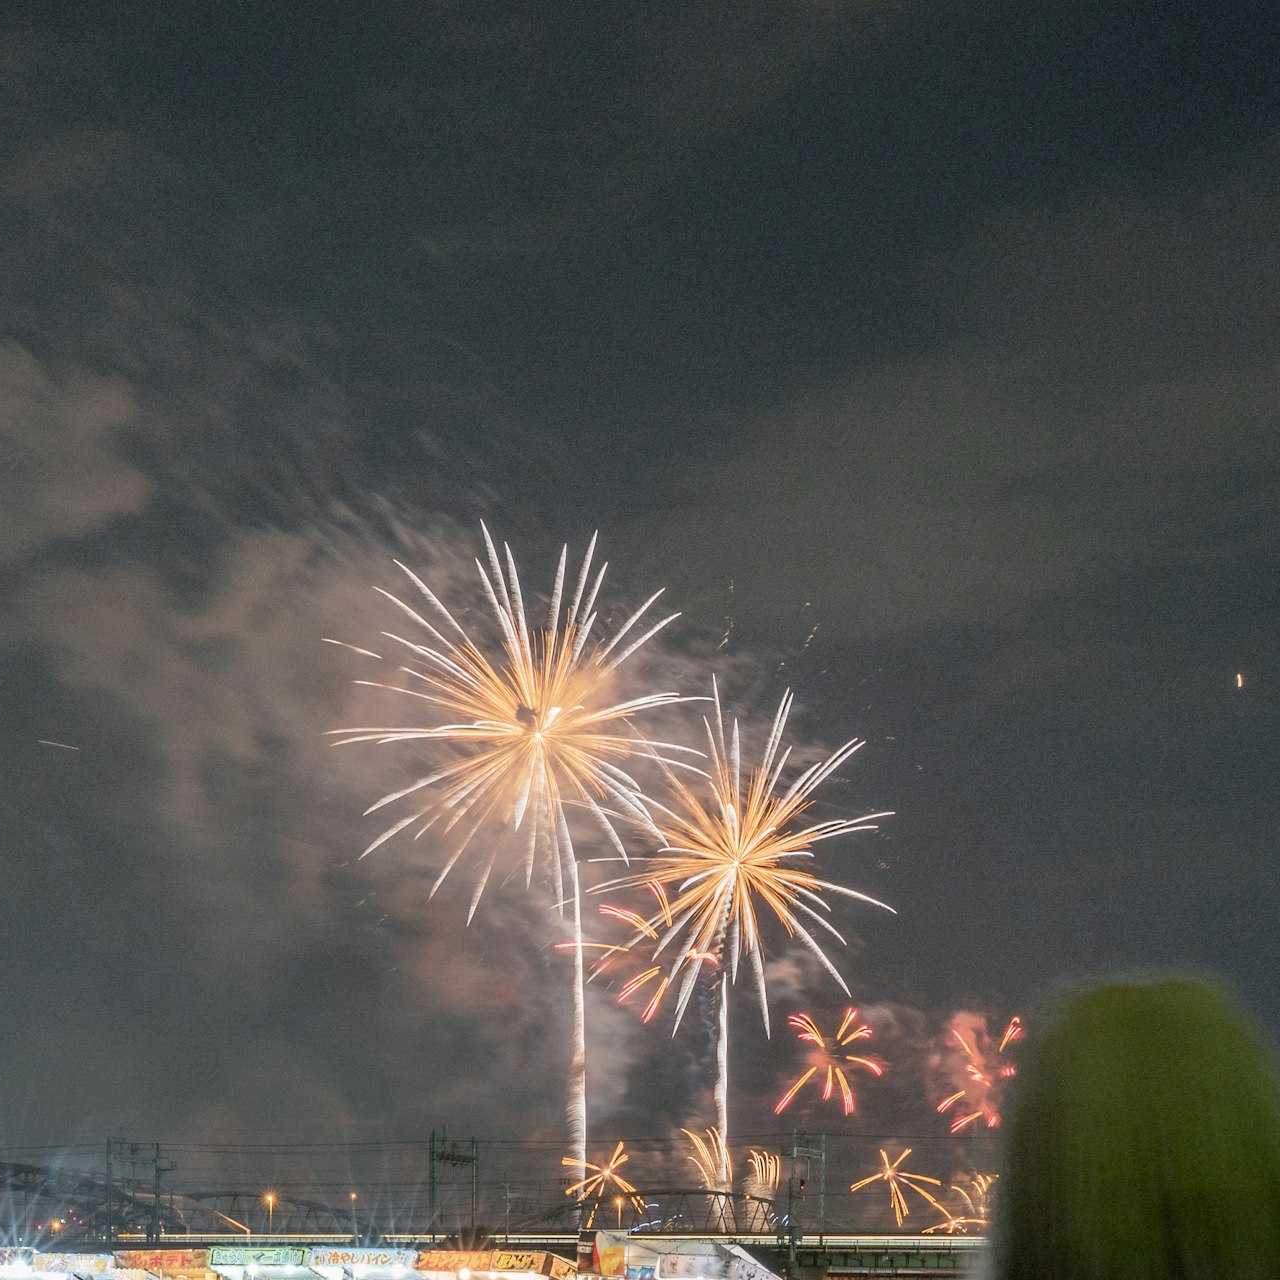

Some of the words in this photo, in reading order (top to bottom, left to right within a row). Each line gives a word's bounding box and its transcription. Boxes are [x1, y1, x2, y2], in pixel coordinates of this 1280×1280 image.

[327, 1250, 392, 1265] 冷やしパイン
[418, 1252, 490, 1269] フランクフルト
